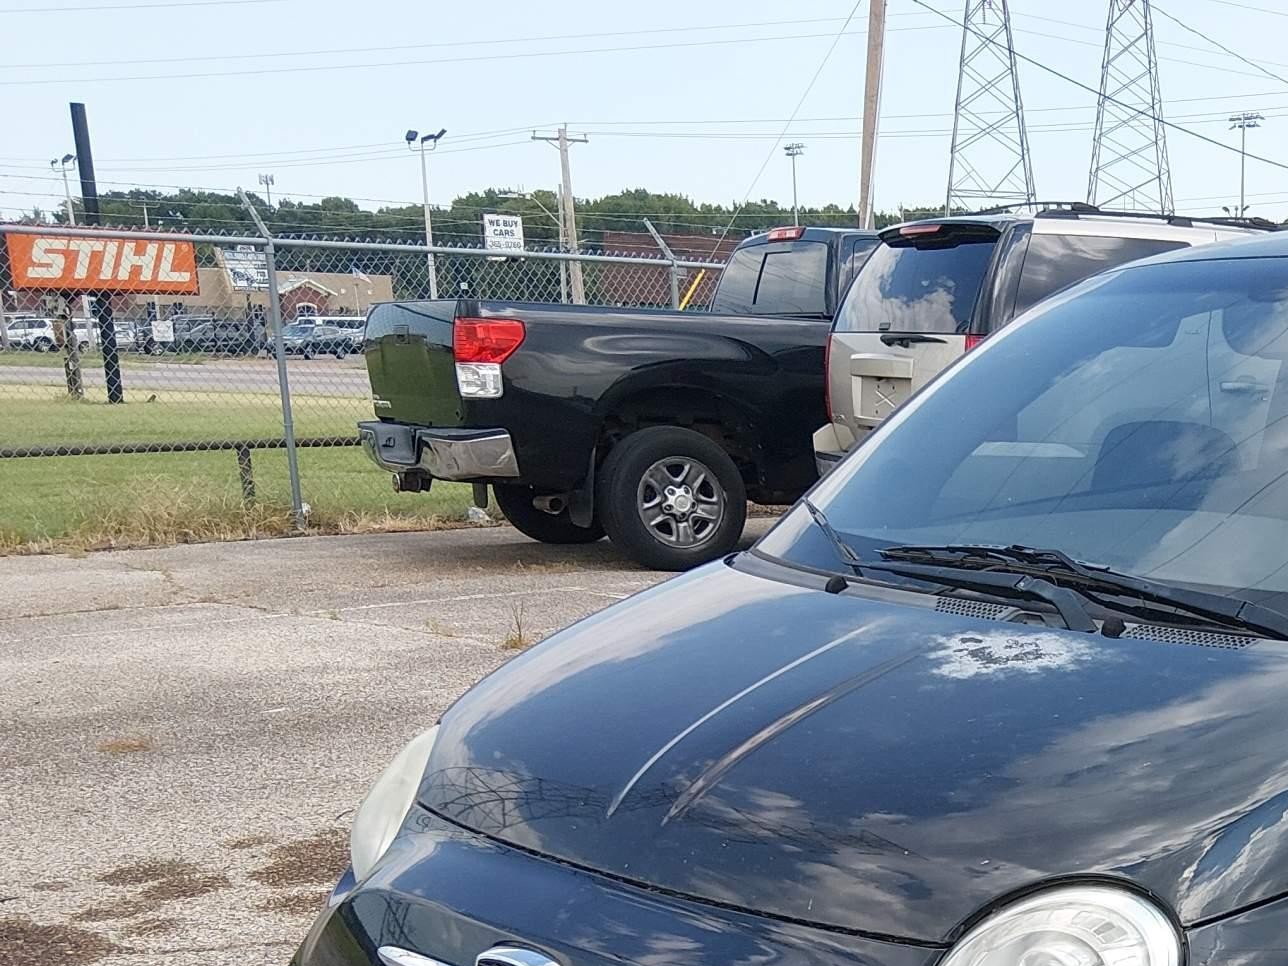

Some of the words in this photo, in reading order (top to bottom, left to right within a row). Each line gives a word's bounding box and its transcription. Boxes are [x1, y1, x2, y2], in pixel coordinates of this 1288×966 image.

[488, 219, 501, 227] WE
[502, 219, 518, 228] BUY
[493, 229, 515, 237] CARS
[26, 238, 191, 282] STIHL
